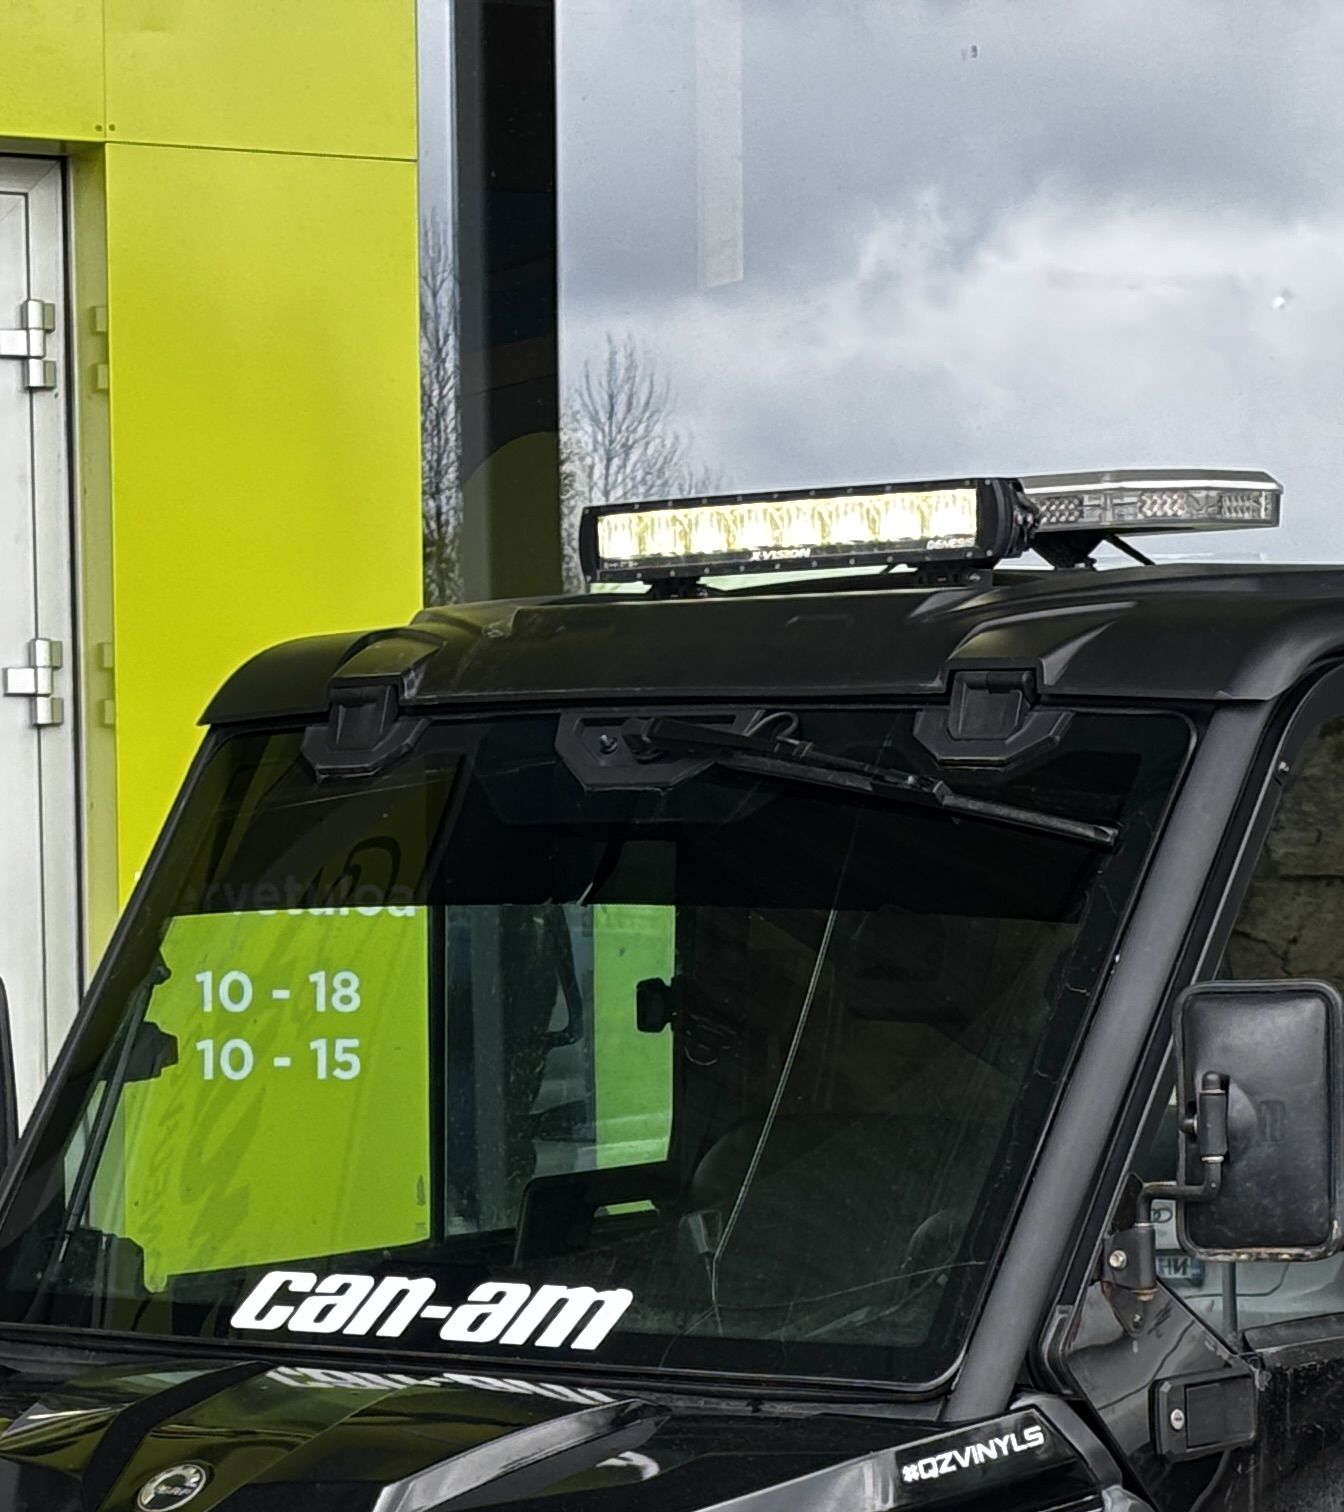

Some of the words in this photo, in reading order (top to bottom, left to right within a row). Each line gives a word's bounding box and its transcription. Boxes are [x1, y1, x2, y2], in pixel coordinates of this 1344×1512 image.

[195, 970, 254, 1013] 10
[272, 989, 291, 1000] -
[308, 970, 361, 1013] 18
[195, 1038, 254, 1081] 10
[273, 1056, 291, 1067] -
[309, 1038, 361, 1081] 15
[230, 1270, 634, 1351] can-am
[902, 1425, 1045, 1483] #QZVINYLS
